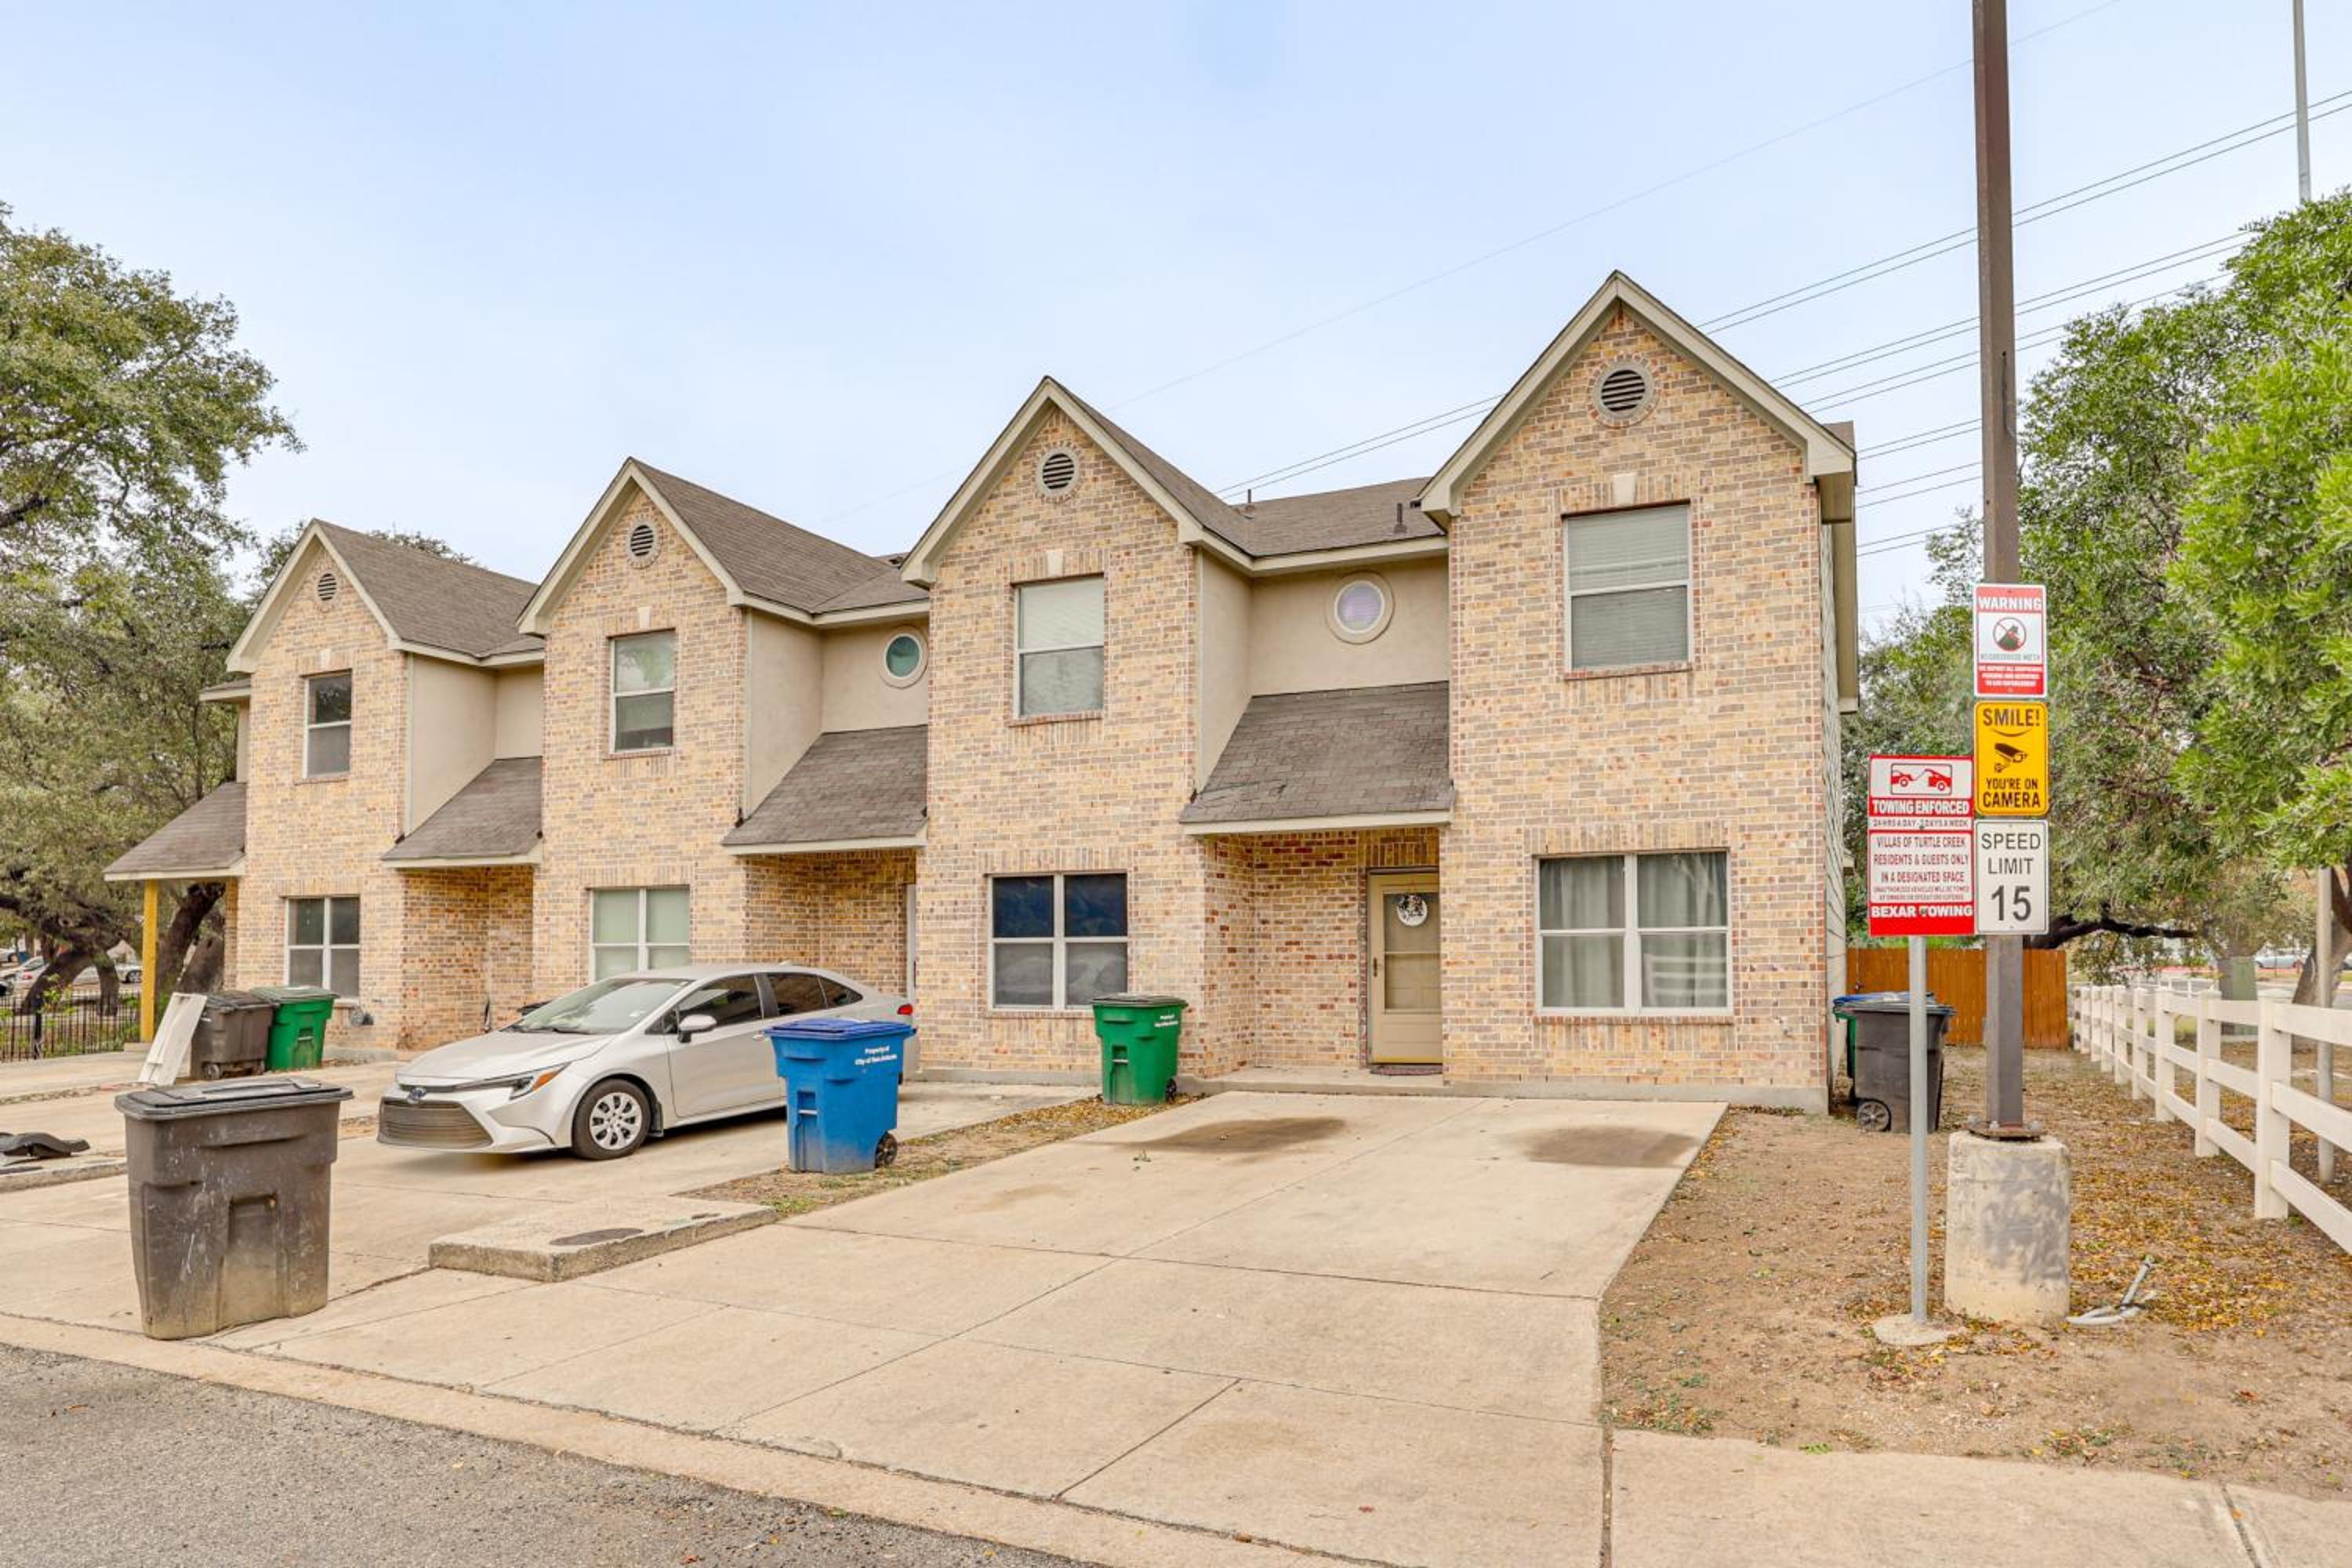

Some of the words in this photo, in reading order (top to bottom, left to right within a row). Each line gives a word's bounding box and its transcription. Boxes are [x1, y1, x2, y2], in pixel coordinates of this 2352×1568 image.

[1978, 595, 2042, 611] WARNING
[1983, 708, 2040, 727] SMILE!
[1986, 778, 2021, 790] YOU'RE
[2024, 778, 2038, 790] ON
[1872, 799, 1914, 815] TOWING
[1915, 800, 1970, 815] ENFORCED
[1983, 791, 2041, 808] CAMERA
[1876, 837, 1901, 848] VILLAS
[1904, 837, 1912, 848] OF
[1914, 837, 1941, 848] TURTLE
[1943, 837, 1965, 848] CREEK
[1981, 833, 2041, 850] SPEED
[1874, 854, 1912, 865] RESIDENTS
[1914, 854, 1920, 865] &
[1922, 854, 1950, 865] GUESTS
[1951, 854, 1969, 865] ONLY
[1988, 857, 2034, 875] LIMIT
[1881, 871, 1889, 883] IN
[1890, 871, 1896, 883] A
[1897, 871, 1940, 883] DESIGNATED
[1942, 871, 1965, 882] SPACE
[1991, 884, 2031, 921] 15
[1871, 906, 1917, 918] BEXAR
[1919, 906, 1973, 916] TOWING
